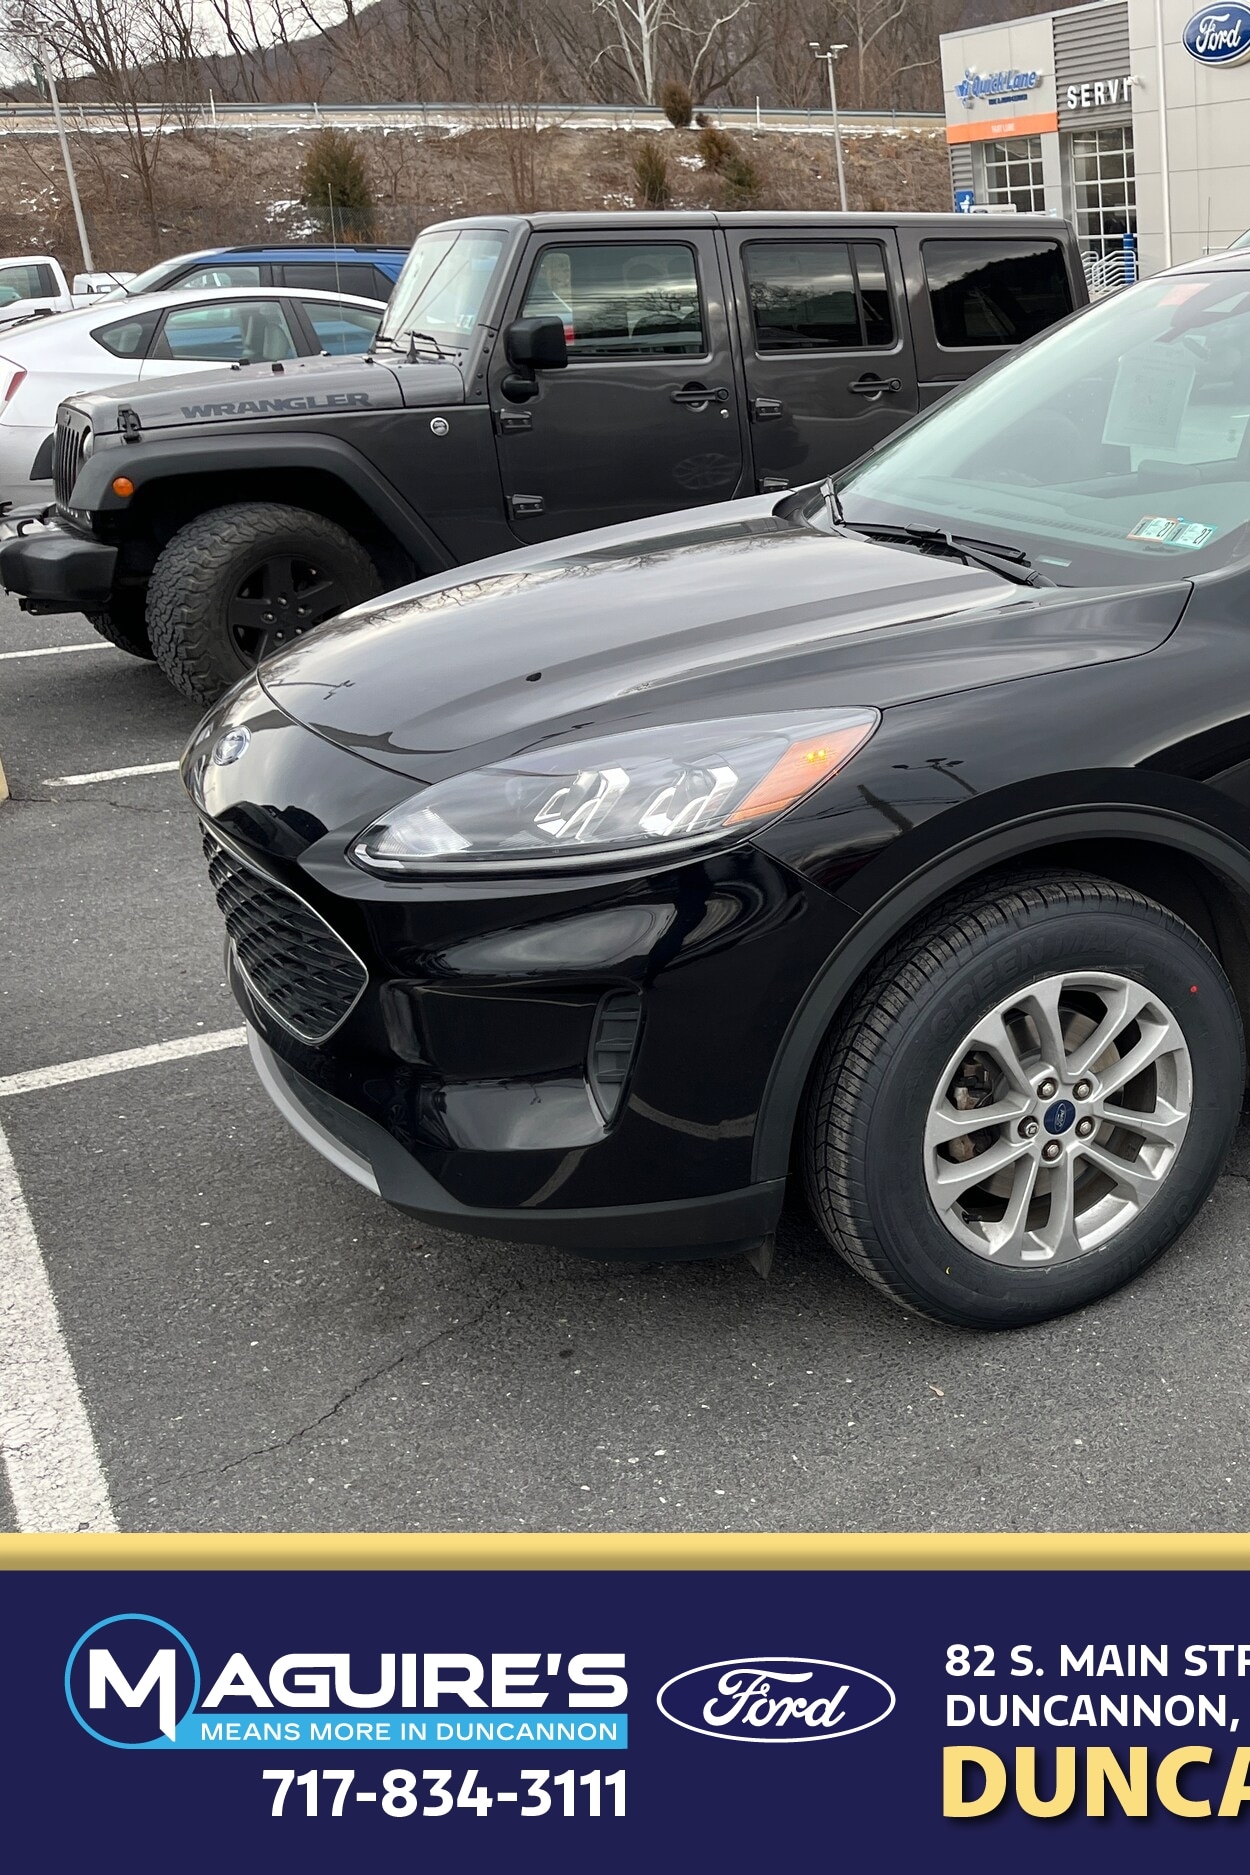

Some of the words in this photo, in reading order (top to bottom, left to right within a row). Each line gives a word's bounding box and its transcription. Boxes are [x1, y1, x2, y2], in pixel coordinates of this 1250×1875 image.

[1196, 13, 1242, 53] Ford
[972, 73, 1004, 97] Quick
[1006, 70, 1036, 90] Lane
[180, 393, 374, 419] WRANGLER
[1156, 521, 1175, 537] 27
[1192, 528, 1212, 545] 27
[929, 934, 1047, 1038] GREEN
